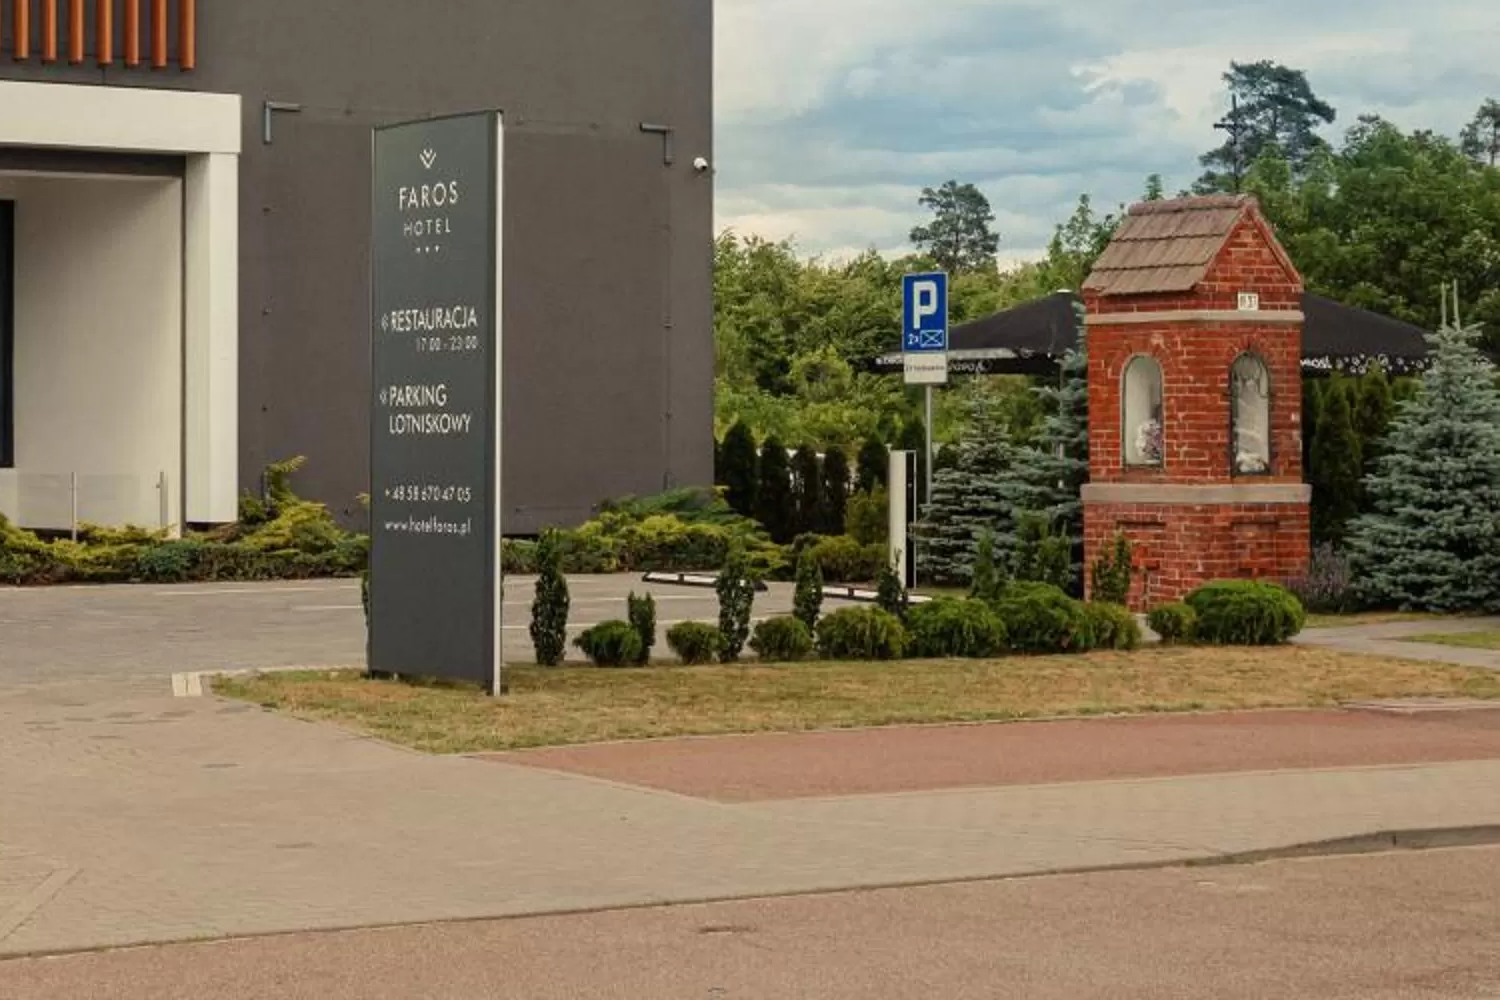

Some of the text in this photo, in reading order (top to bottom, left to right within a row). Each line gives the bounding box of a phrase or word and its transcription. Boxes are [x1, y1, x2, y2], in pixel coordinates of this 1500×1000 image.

[399, 181, 459, 211] FAROS
[403, 218, 451, 237] HOTEL
[913, 281, 938, 329] P
[391, 305, 478, 332] RESTAURACJA
[389, 384, 447, 407] PARKING
[389, 413, 471, 434] LOTNISKOWY
